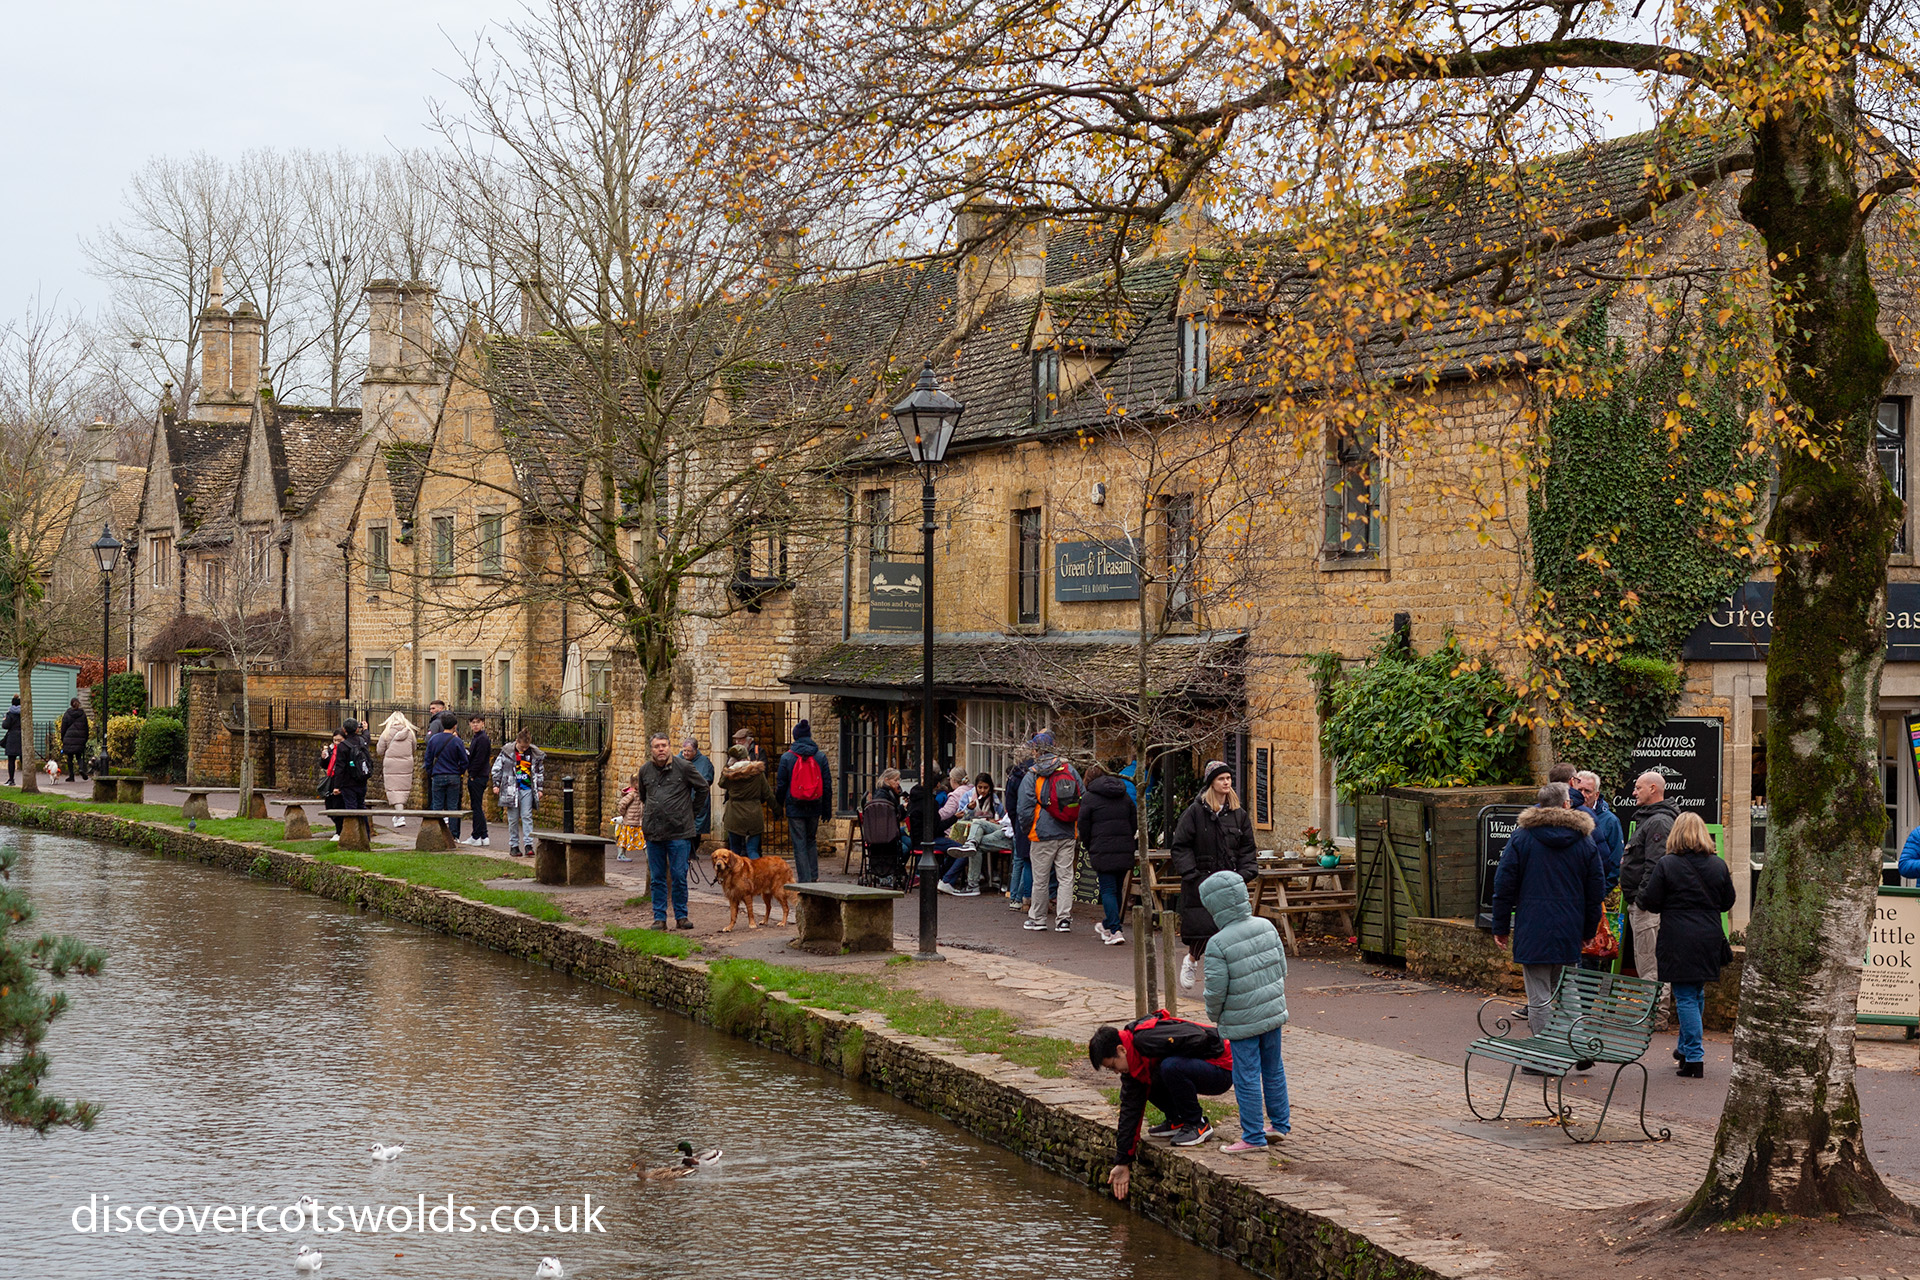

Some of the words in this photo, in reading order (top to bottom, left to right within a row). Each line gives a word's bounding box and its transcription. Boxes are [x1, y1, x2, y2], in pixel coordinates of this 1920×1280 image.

[1061, 552, 1086, 578] Green
[1088, 552, 1096, 576] &
[1097, 548, 1132, 575] Pleasant
[1082, 584, 1091, 594] TEA
[1092, 584, 1110, 593] ROOMS
[1708, 595, 1774, 628] Gree
[1638, 734, 1696, 748] instones
[1675, 796, 1705, 806] Cream
[1490, 822, 1520, 832] Winst
[1874, 908, 1897, 920] he
[1873, 926, 1916, 945] ittle
[1864, 950, 1912, 968] ook
